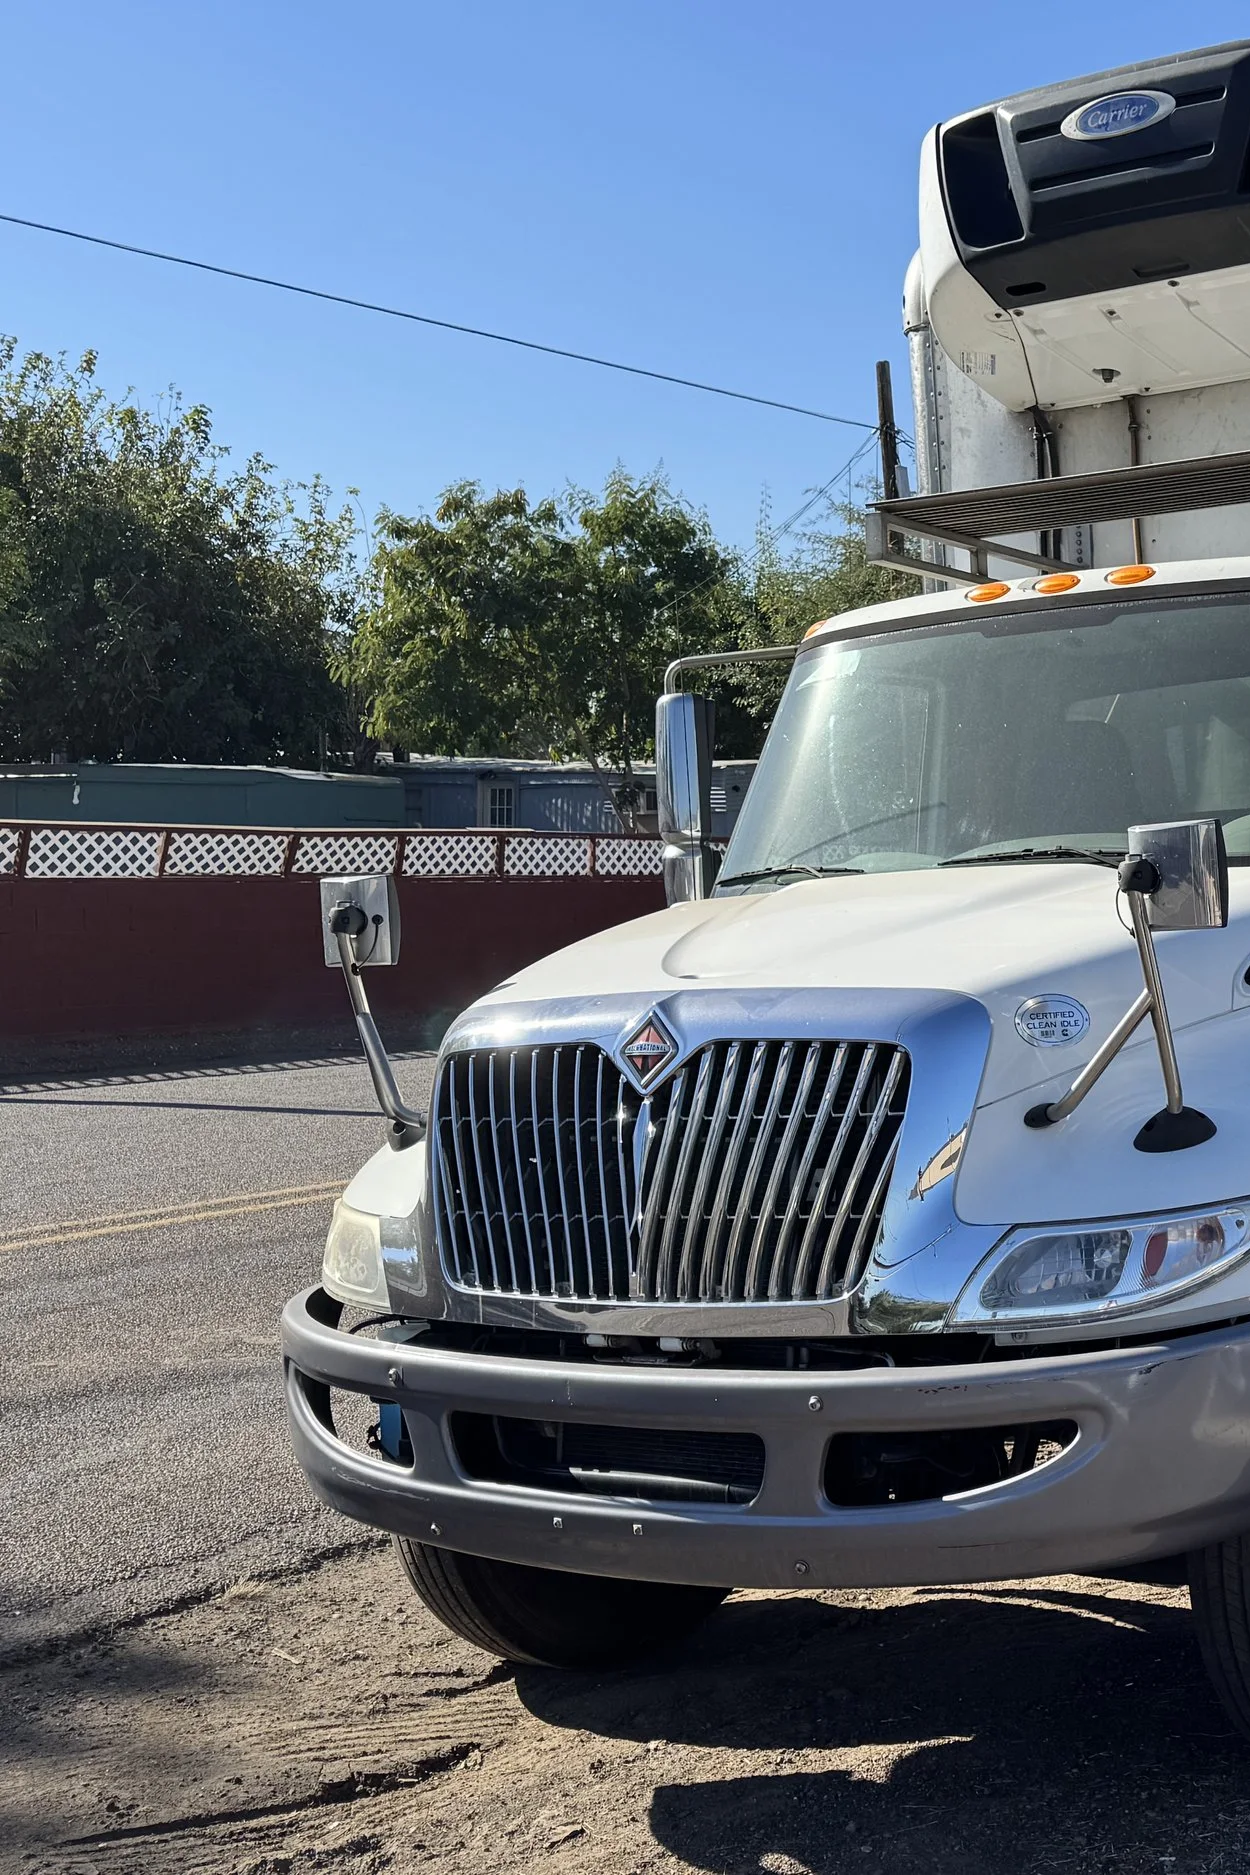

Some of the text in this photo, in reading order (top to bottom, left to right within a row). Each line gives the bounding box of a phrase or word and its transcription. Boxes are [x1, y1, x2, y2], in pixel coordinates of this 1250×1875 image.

[1087, 104, 1147, 128] Carrier
[1029, 1011, 1075, 1020] CERTIFIED
[1026, 1019, 1080, 1030] CLEAN IDLE
